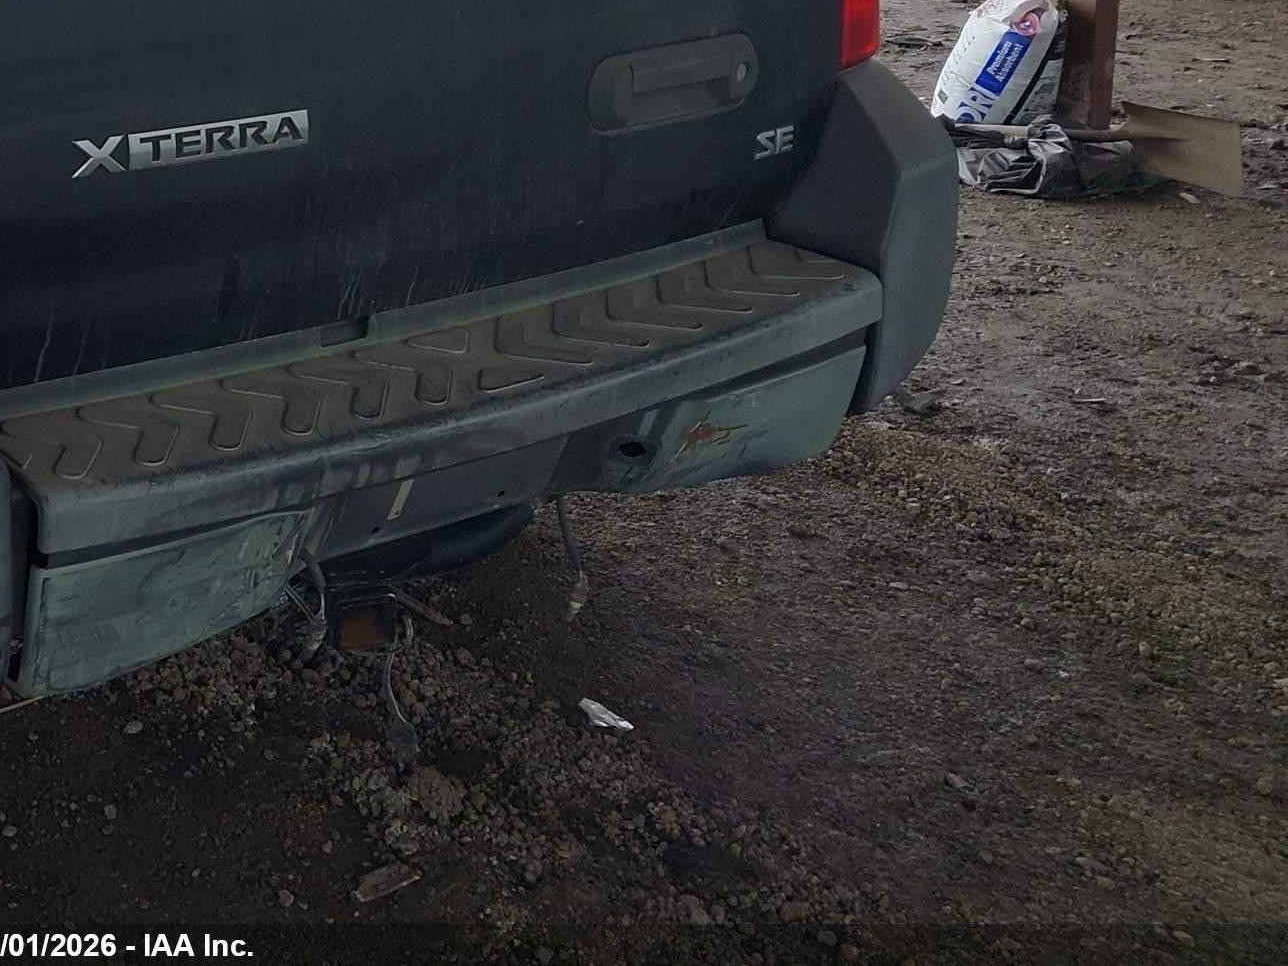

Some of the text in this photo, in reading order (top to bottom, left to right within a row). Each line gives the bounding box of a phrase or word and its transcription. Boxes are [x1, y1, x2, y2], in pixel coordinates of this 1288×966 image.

[986, 41, 1013, 75] Premium
[994, 43, 1024, 83] Absorbent
[754, 125, 795, 160] SE
